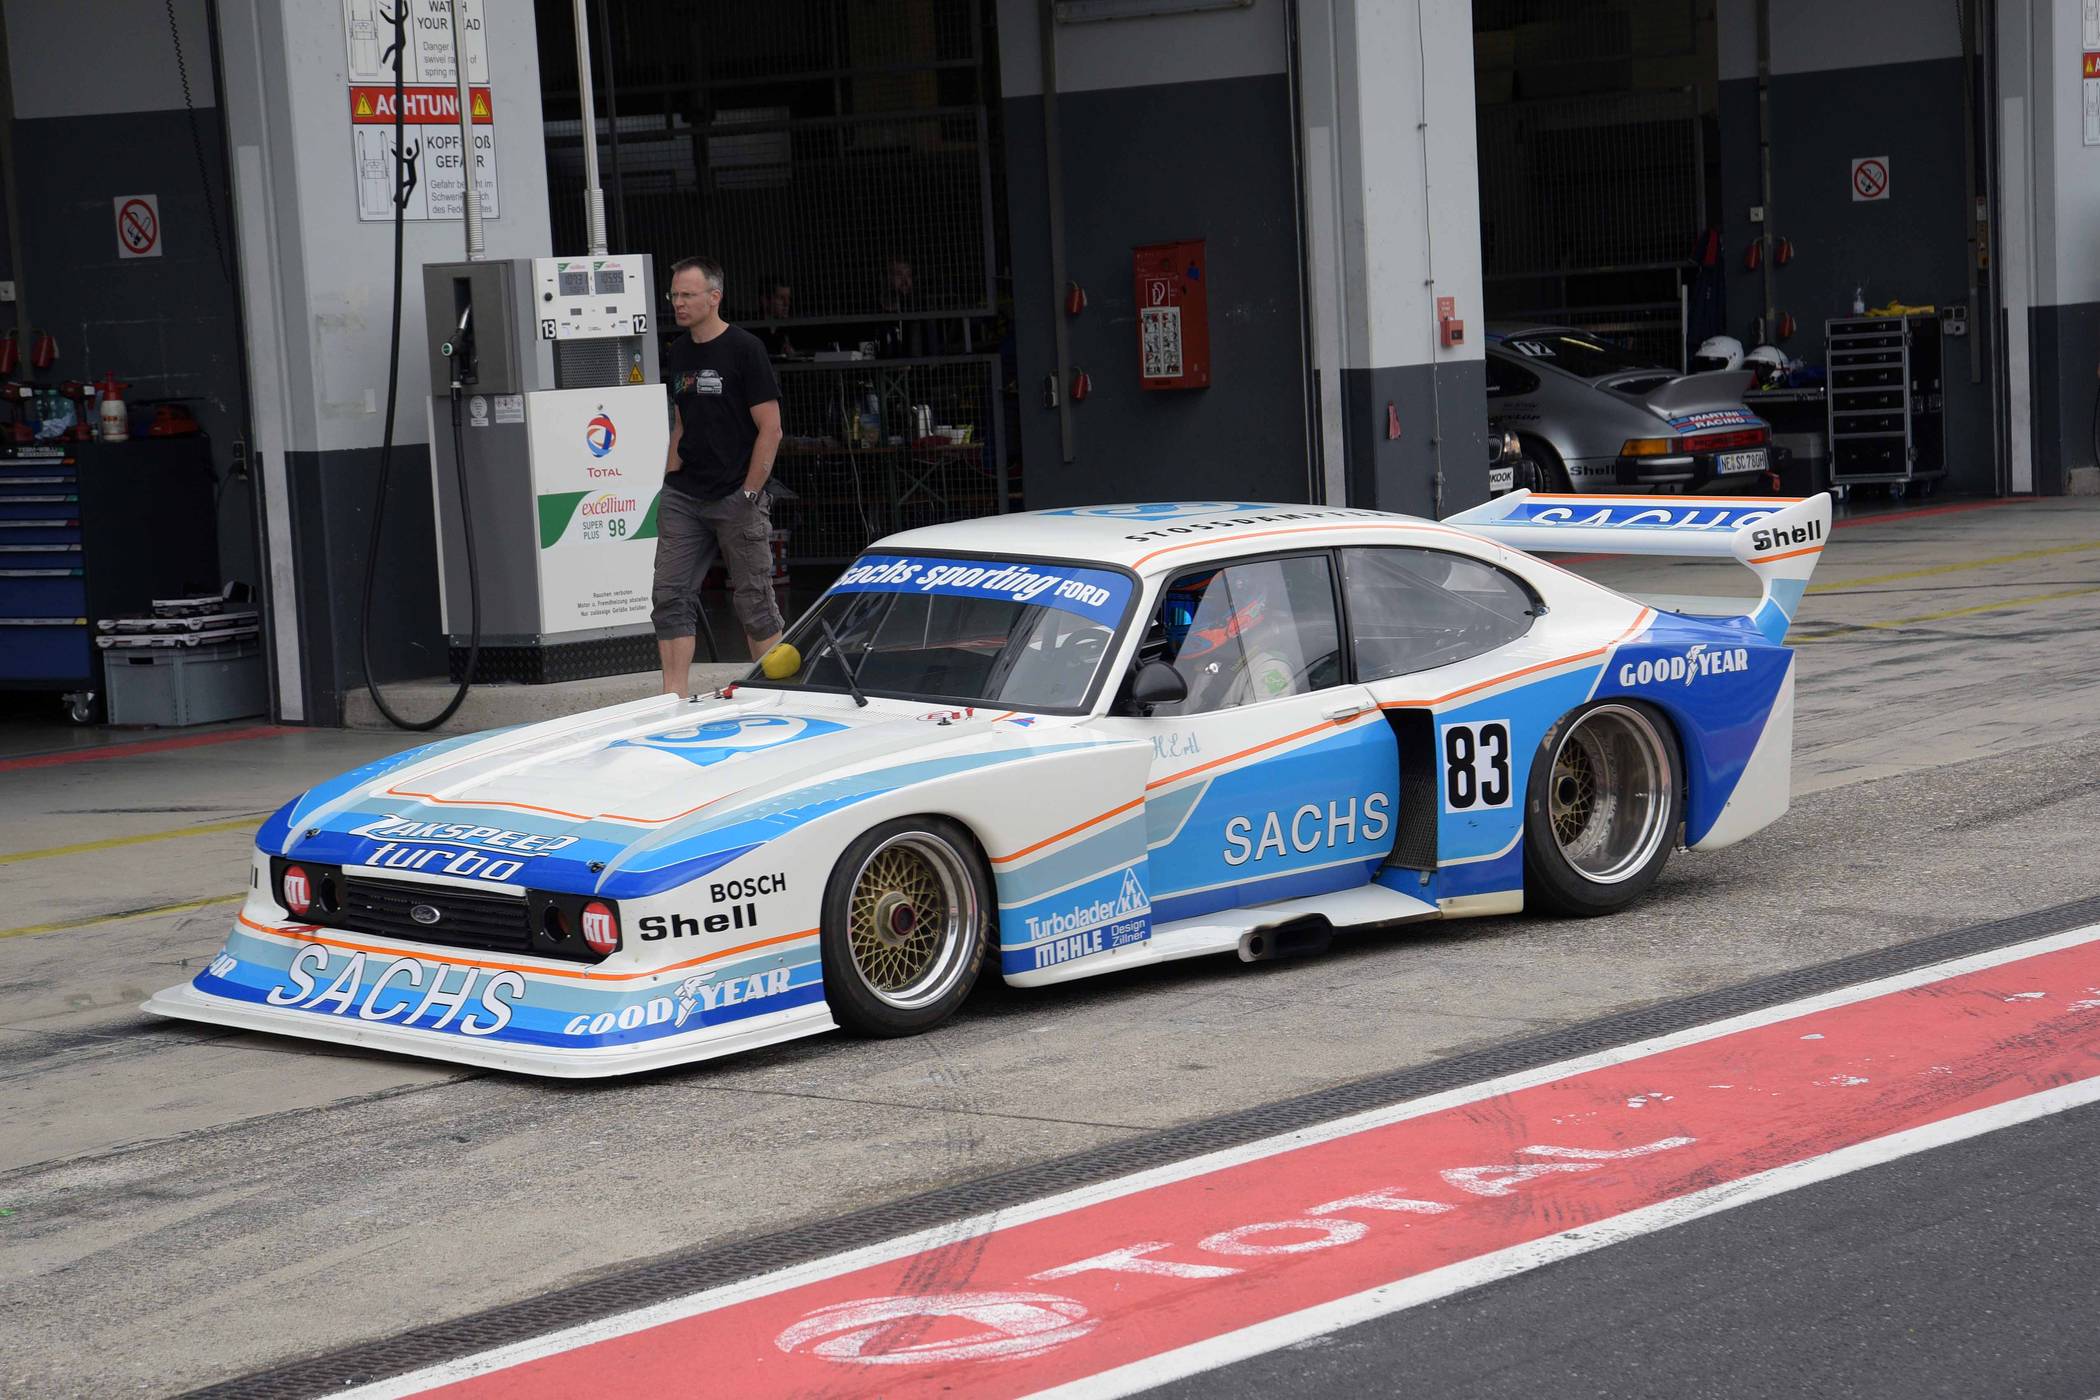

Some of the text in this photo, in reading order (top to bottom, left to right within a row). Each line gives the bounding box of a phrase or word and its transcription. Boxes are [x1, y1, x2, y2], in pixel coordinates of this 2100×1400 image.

[417, 17, 448, 30] YOUR
[425, 69, 448, 79] spring
[427, 134, 491, 149] KOPFOß
[436, 155, 484, 168] GEFR
[431, 180, 455, 189] Gefahr
[542, 321, 556, 338] 13
[633, 315, 647, 333] 12
[1689, 411, 1739, 423] MARTINI
[1694, 416, 1745, 429] RACING
[587, 467, 622, 478] TOTAL
[1569, 464, 1616, 476] Shell
[582, 496, 636, 516] excellium
[583, 520, 603, 531] SUPER
[584, 530, 600, 540] PLUS
[608, 518, 626, 538] 98
[1752, 519, 1822, 551] Shell
[916, 564, 1062, 601] sporting
[1053, 580, 1111, 607] FORD
[1446, 723, 1509, 809] 83
[348, 813, 581, 856] ZAKSPEED
[1222, 791, 1390, 867] SACHS
[364, 842, 525, 881] turbo
[283, 874, 311, 906] RTL
[710, 872, 787, 904] BOSCH
[581, 911, 618, 944] RTL
[638, 902, 757, 942] Shell
[1025, 900, 1116, 941] Turbolader
[1111, 919, 1146, 937] Design
[1034, 928, 1103, 969] MAHLE
[1112, 930, 1146, 947] Zillner
[265, 943, 527, 1036] SACHS
[1023, 1136, 1700, 1280] TOTAL
